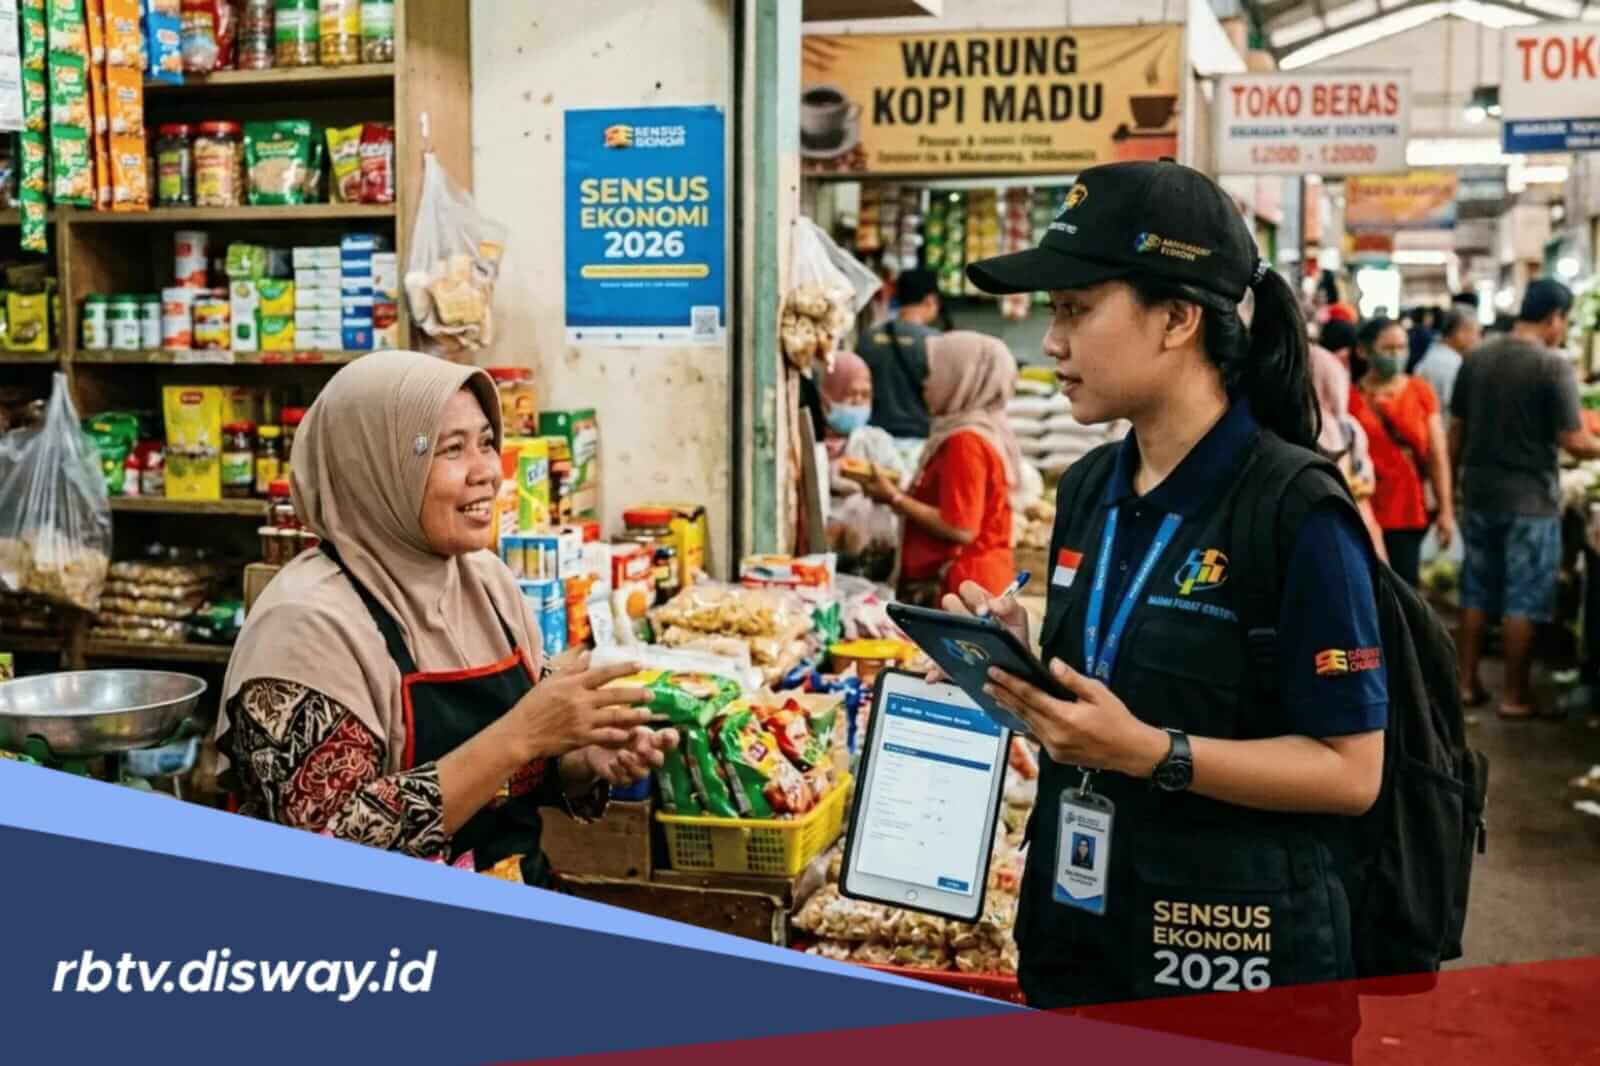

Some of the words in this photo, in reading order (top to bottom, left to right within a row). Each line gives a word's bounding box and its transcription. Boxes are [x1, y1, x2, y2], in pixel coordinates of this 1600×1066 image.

[901, 36, 1078, 78] WARUNG
[1516, 35, 1600, 81] TOK
[873, 84, 965, 125] KOPI
[983, 82, 1104, 123] MADU
[1231, 85, 1302, 117] TOKO
[1312, 83, 1399, 117] BERAS
[579, 176, 710, 204] SENSUS
[580, 206, 709, 229] EKONOMI
[603, 230, 685, 258] 2026
[1152, 900, 1271, 928] SENSUS
[1153, 926, 1271, 952] EKONOMI
[1153, 950, 1271, 992] 2026
